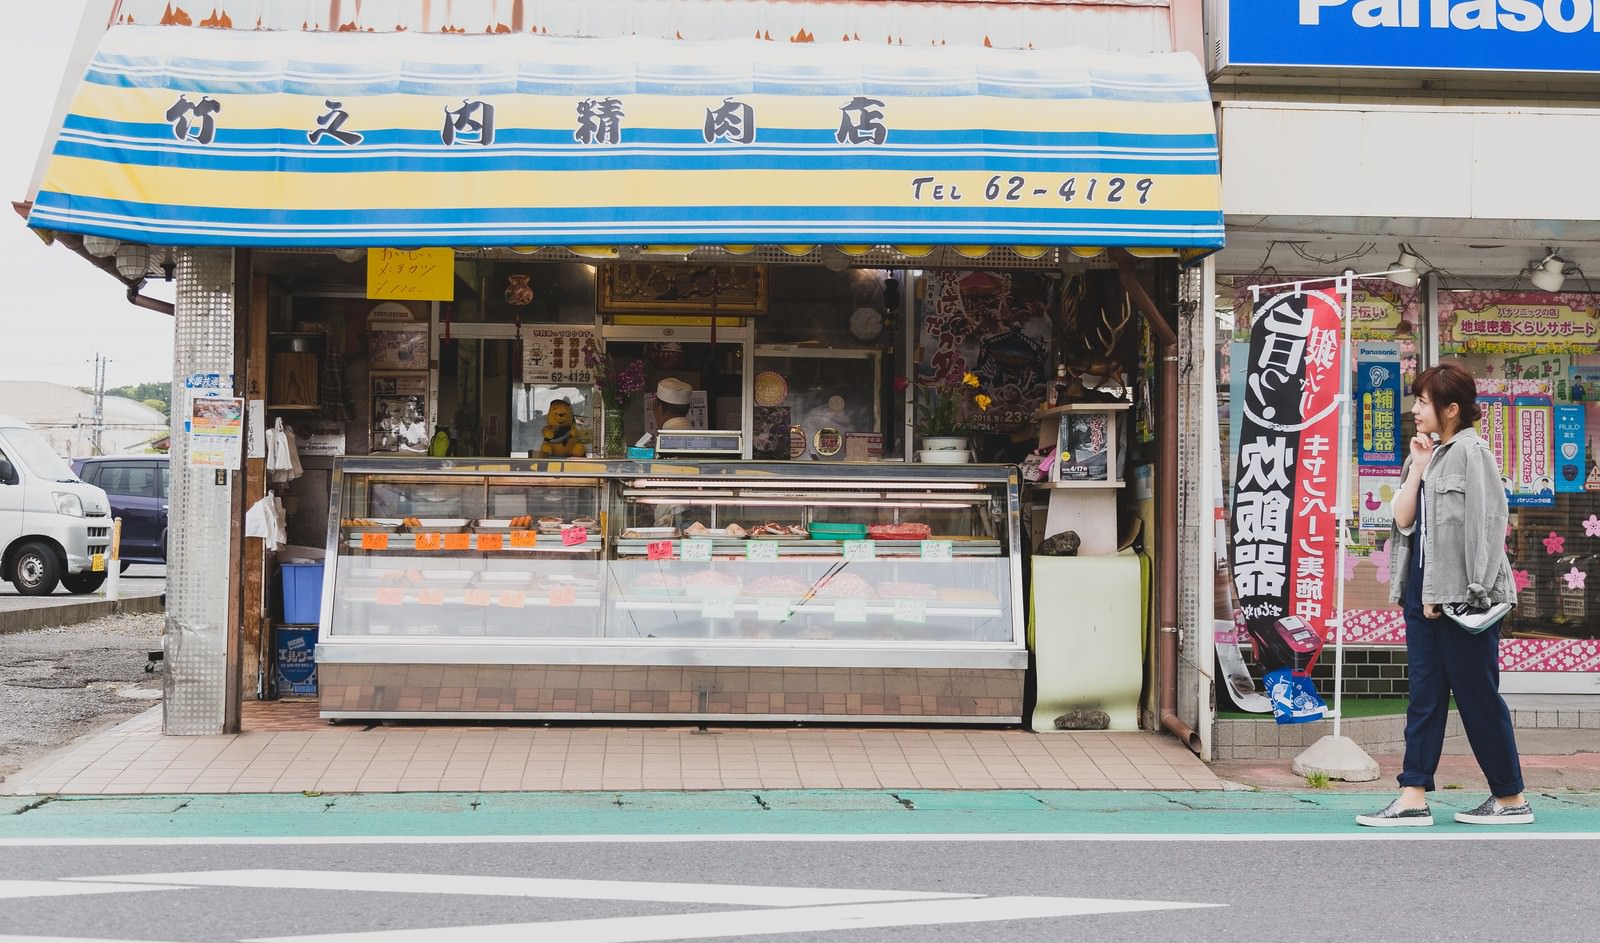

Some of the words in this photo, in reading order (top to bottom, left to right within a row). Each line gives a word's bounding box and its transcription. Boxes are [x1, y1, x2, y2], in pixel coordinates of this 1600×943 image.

[1299, 0, 1600, 32] Panaso
[166, 94, 888, 146] 竹之内精肉店
[912, 177, 962, 201] TEL
[985, 176, 1154, 204] 62-4129
[1498, 307, 1558, 318] パナソニックの店
[1461, 320, 1596, 335] 地域密着くらしサポート
[1360, 348, 1397, 356] Panasonic
[551, 372, 590, 382] 62-4129
[1374, 389, 1395, 452] 補聴器
